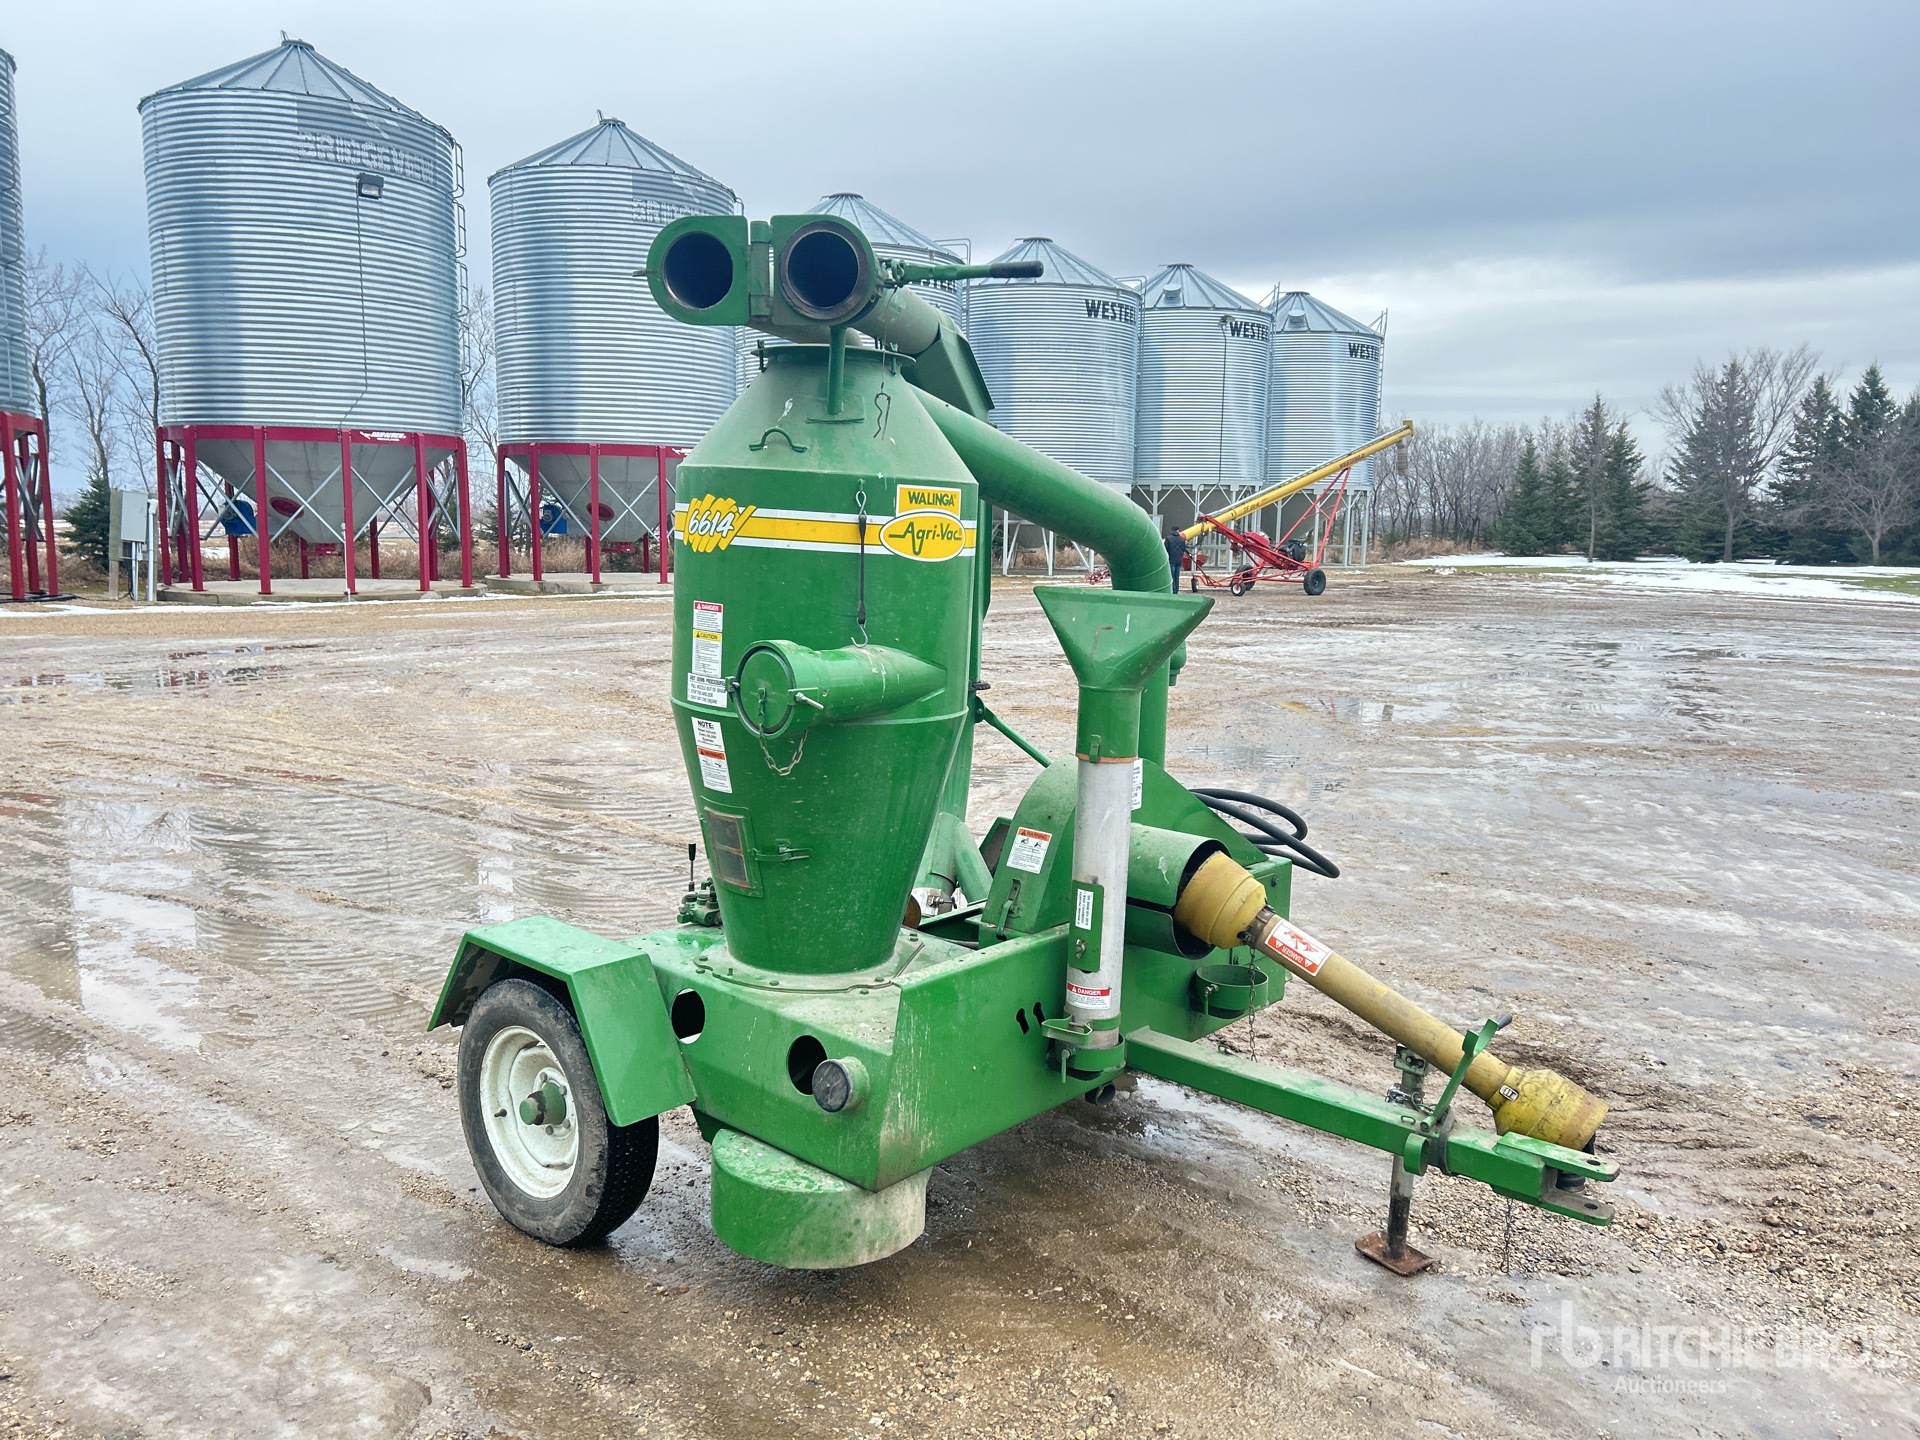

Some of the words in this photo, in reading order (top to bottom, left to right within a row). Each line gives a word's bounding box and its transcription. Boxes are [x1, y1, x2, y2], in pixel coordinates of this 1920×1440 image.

[908, 491, 955, 507] WALINGA
[688, 509, 736, 538] 6614
[888, 521, 962, 556] Agri-Vac
[697, 720, 714, 728] NOTE:
[1281, 945, 1303, 963] DANGER
[1077, 988, 1102, 996] DANGER
